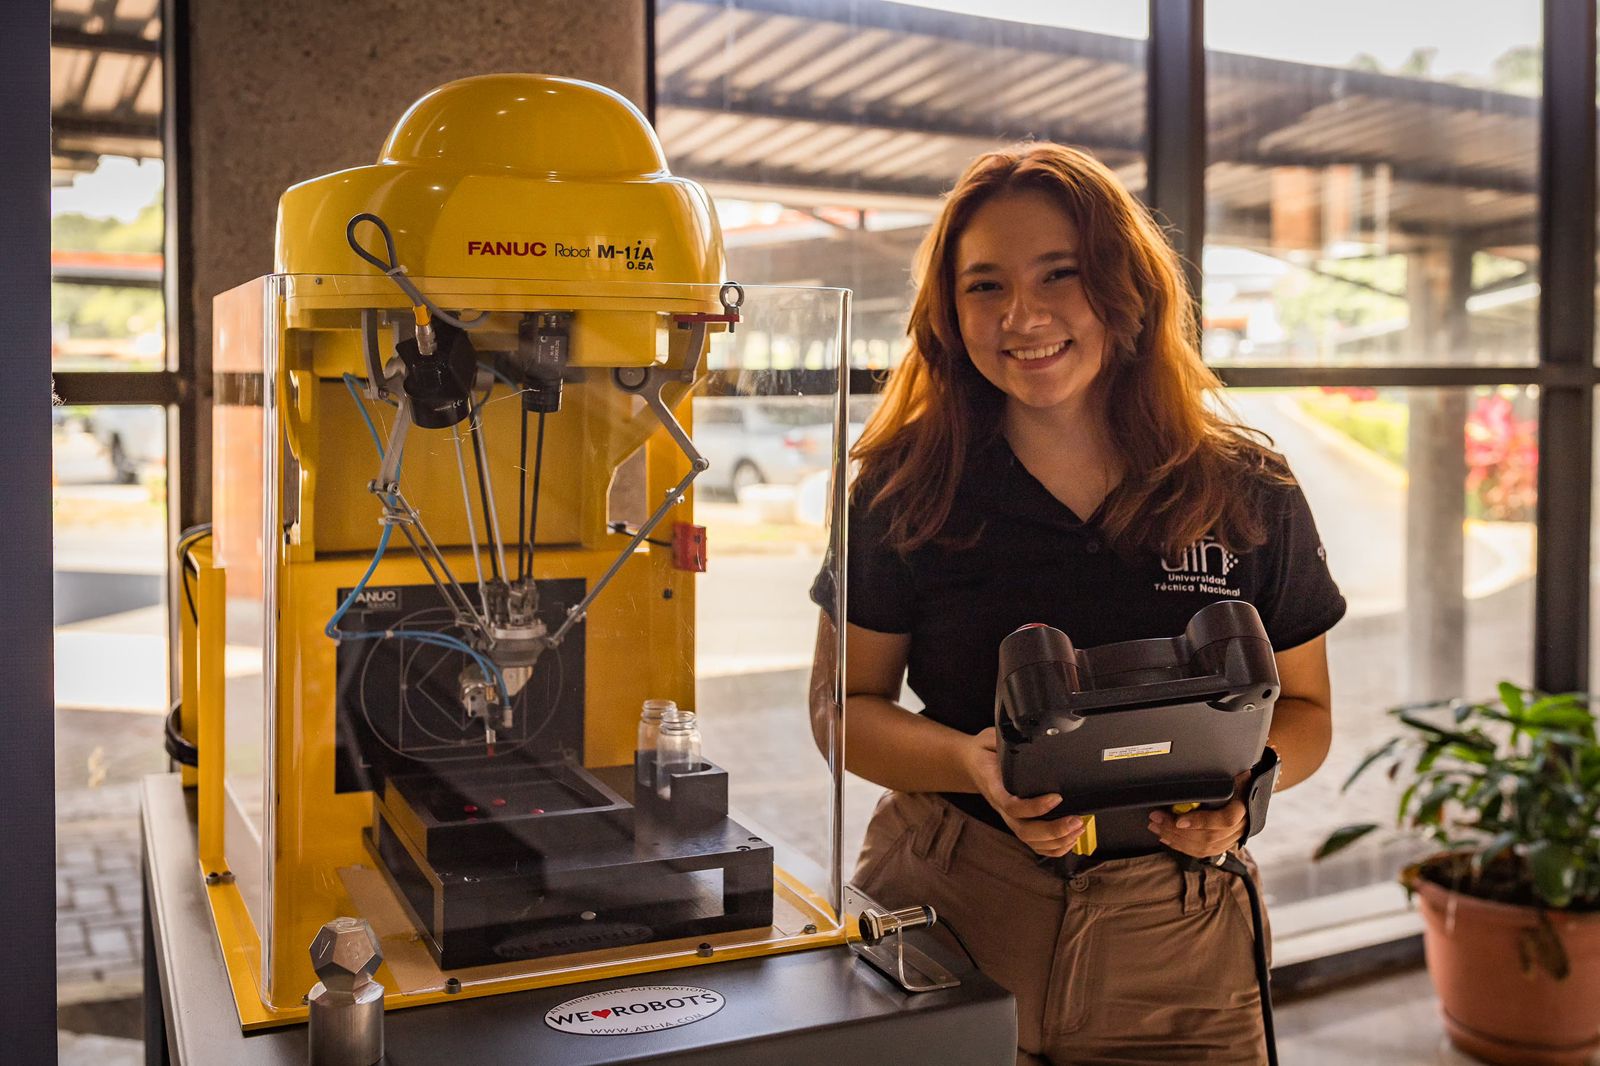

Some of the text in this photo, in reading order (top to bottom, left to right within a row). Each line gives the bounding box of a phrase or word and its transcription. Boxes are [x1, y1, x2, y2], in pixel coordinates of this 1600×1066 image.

[468, 240, 654, 260] FANUC Robot M-1iA
[626, 261, 654, 271] 0.5A
[1168, 573, 1227, 586] Universidad
[1154, 583, 1241, 597] Técnica Nacional
[547, 993, 718, 1026] WE ROBOTS
[550, 1005, 564, 1014] ATI
[565, 989, 627, 1007] INDUSTRIAL
[590, 1013, 704, 1034] WWW.ATI-IA.COM
